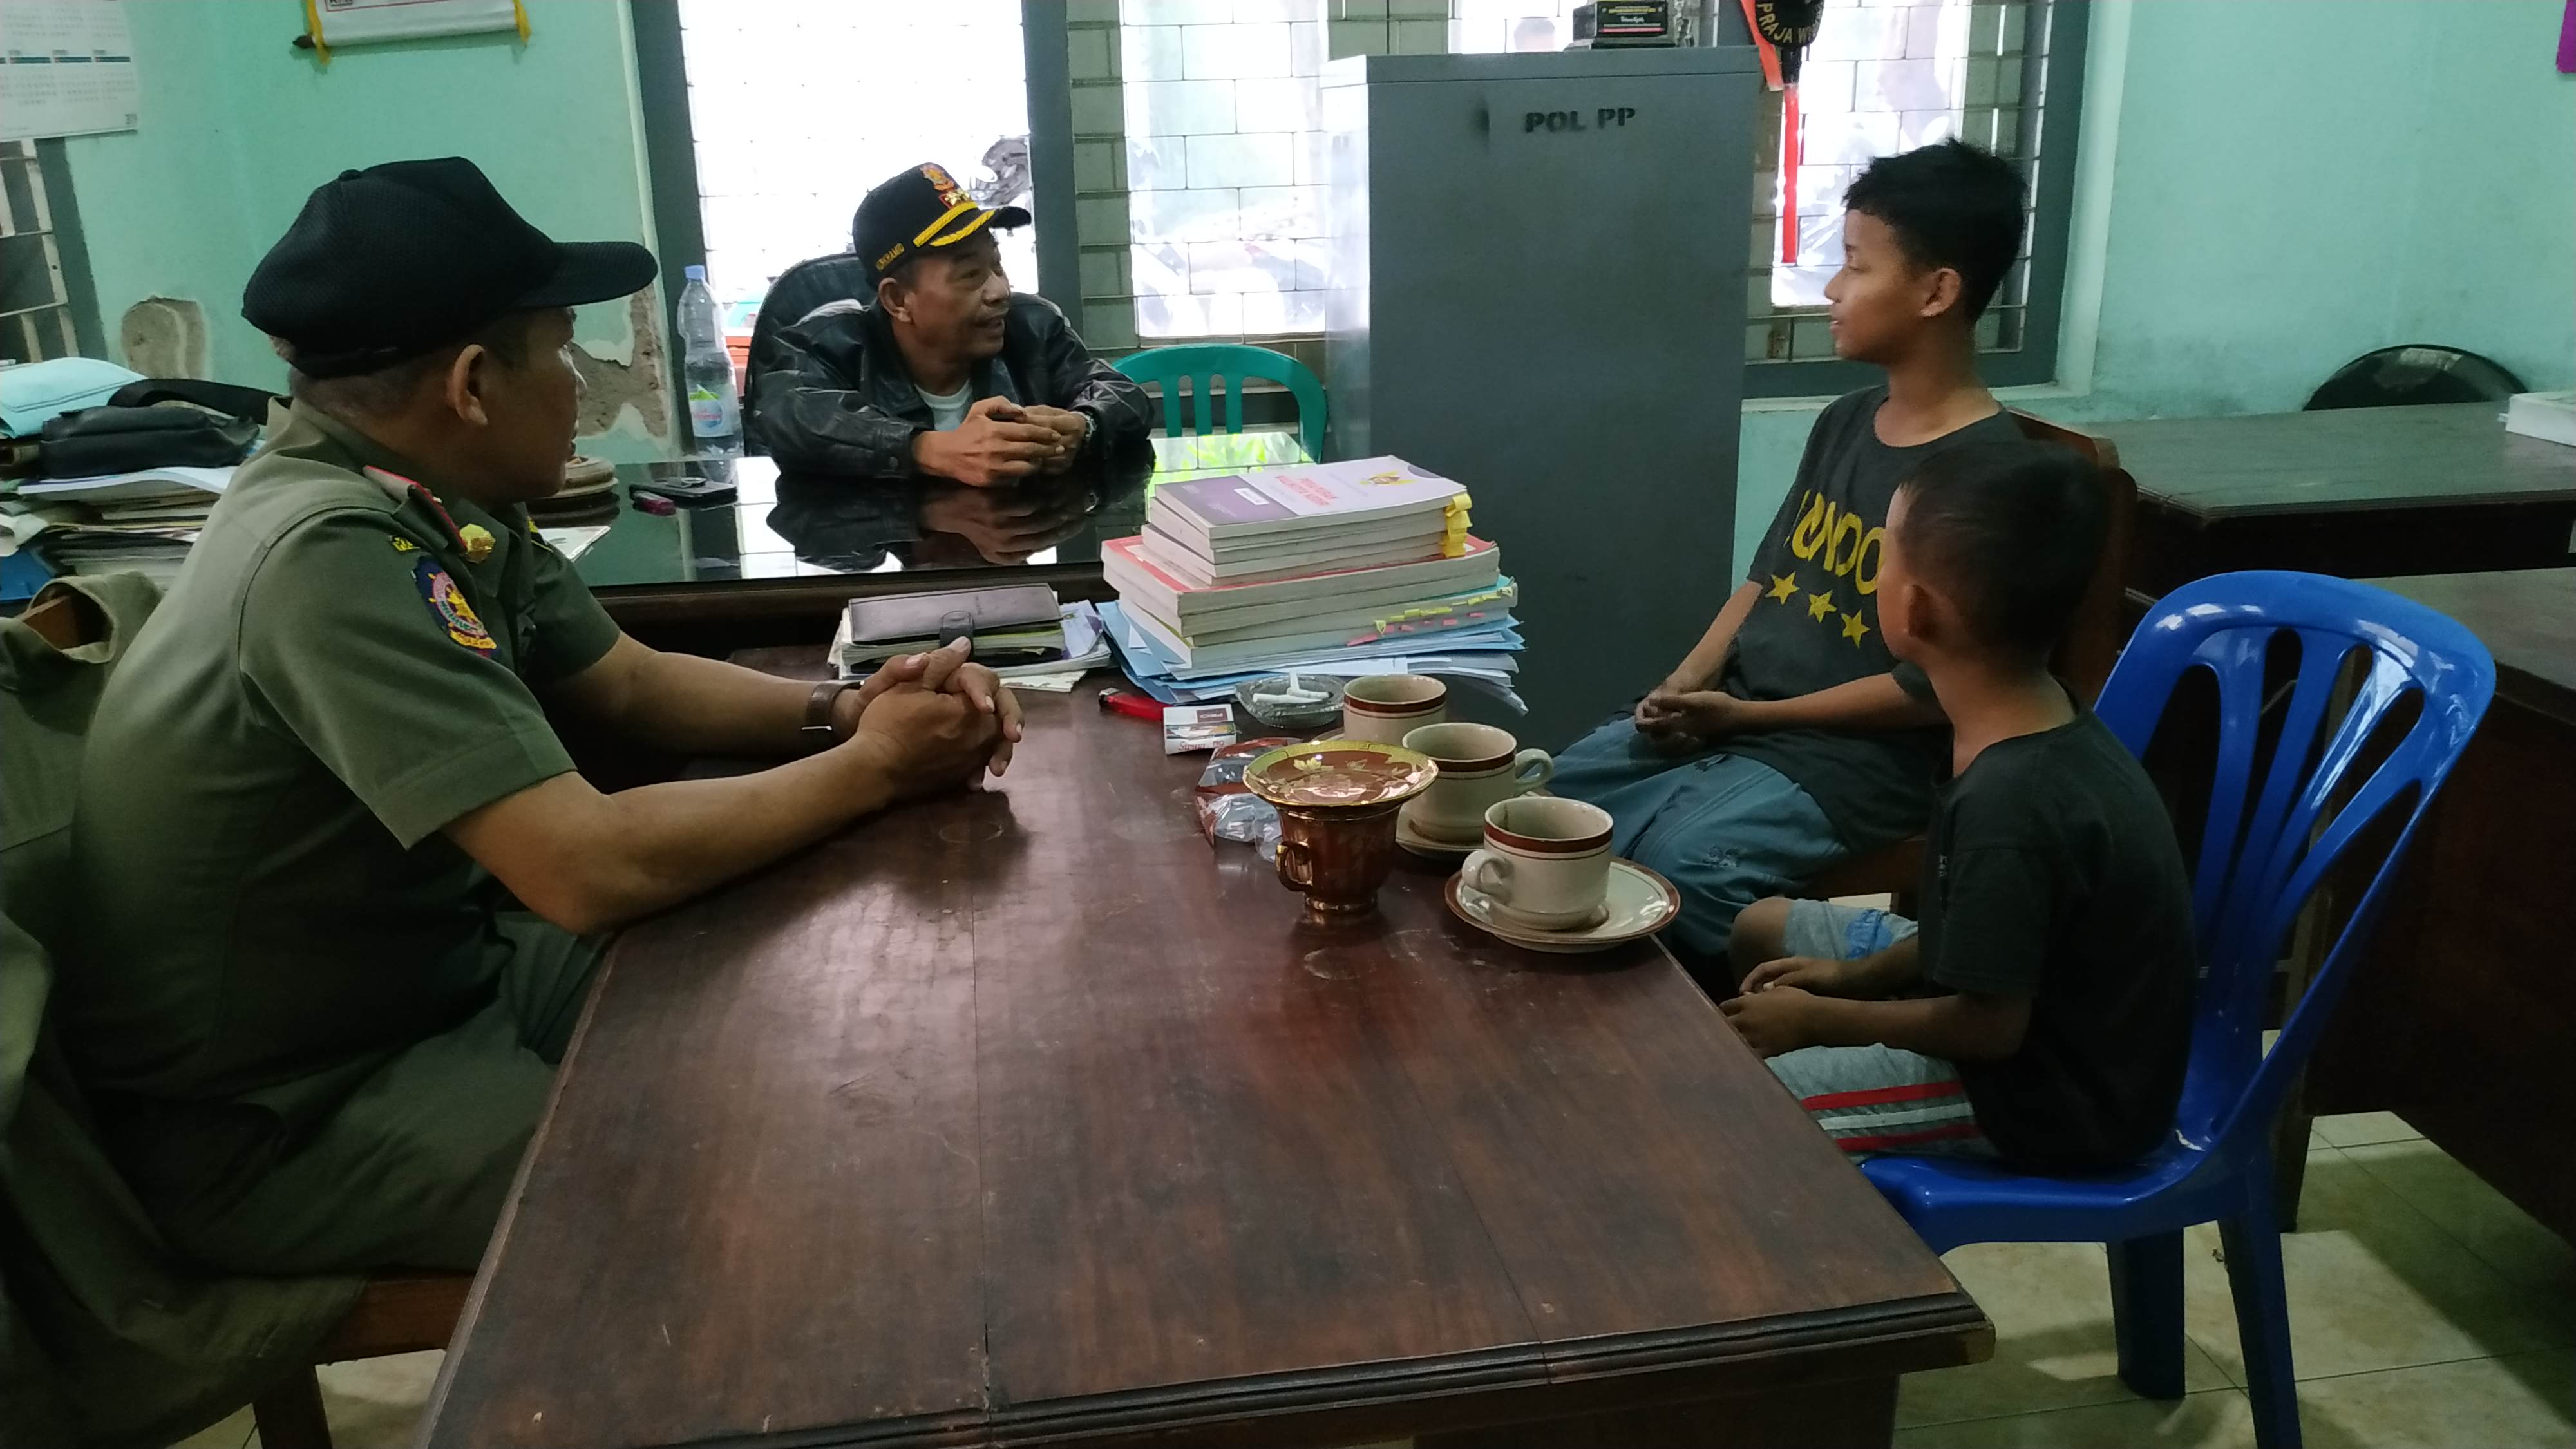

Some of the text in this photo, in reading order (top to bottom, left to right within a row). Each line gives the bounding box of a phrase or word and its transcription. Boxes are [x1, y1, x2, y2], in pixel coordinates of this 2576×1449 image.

[1757, 3, 1793, 43] PRAJA
[1525, 108, 1636, 133] POL PP
